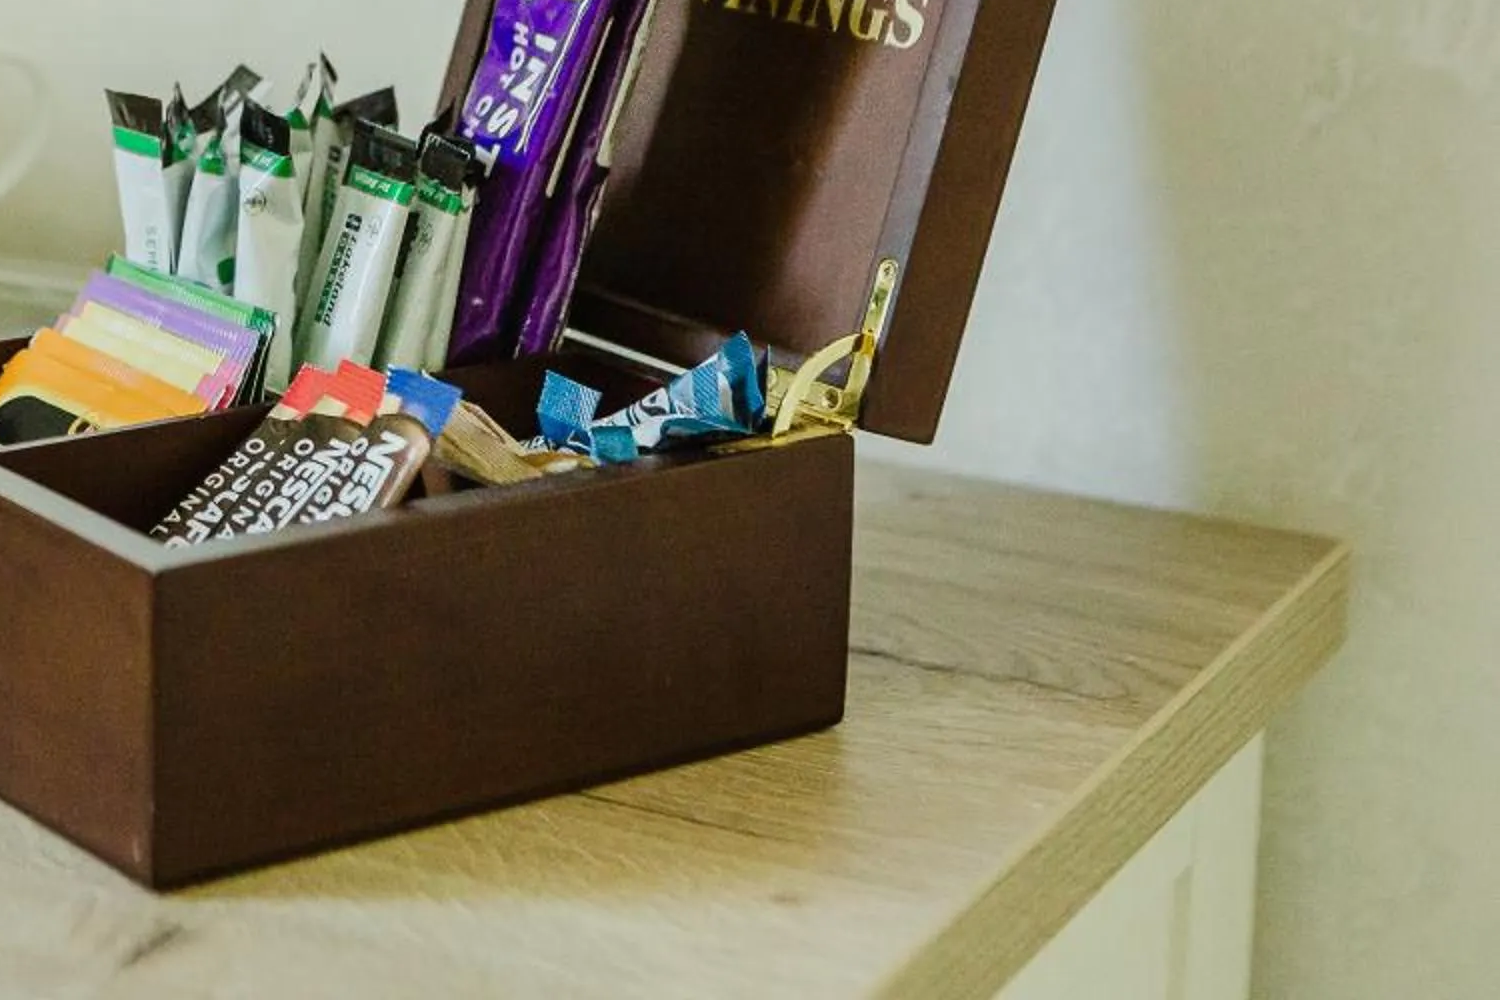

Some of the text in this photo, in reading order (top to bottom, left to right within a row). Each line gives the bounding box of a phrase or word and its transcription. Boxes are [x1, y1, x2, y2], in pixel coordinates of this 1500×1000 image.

[500, 21, 529, 90] HOT
[475, 33, 557, 178] INST
[149, 438, 265, 535] ORIGINAL
[216, 438, 315, 541] ORIGINA
[246, 438, 350, 534] NESCA
